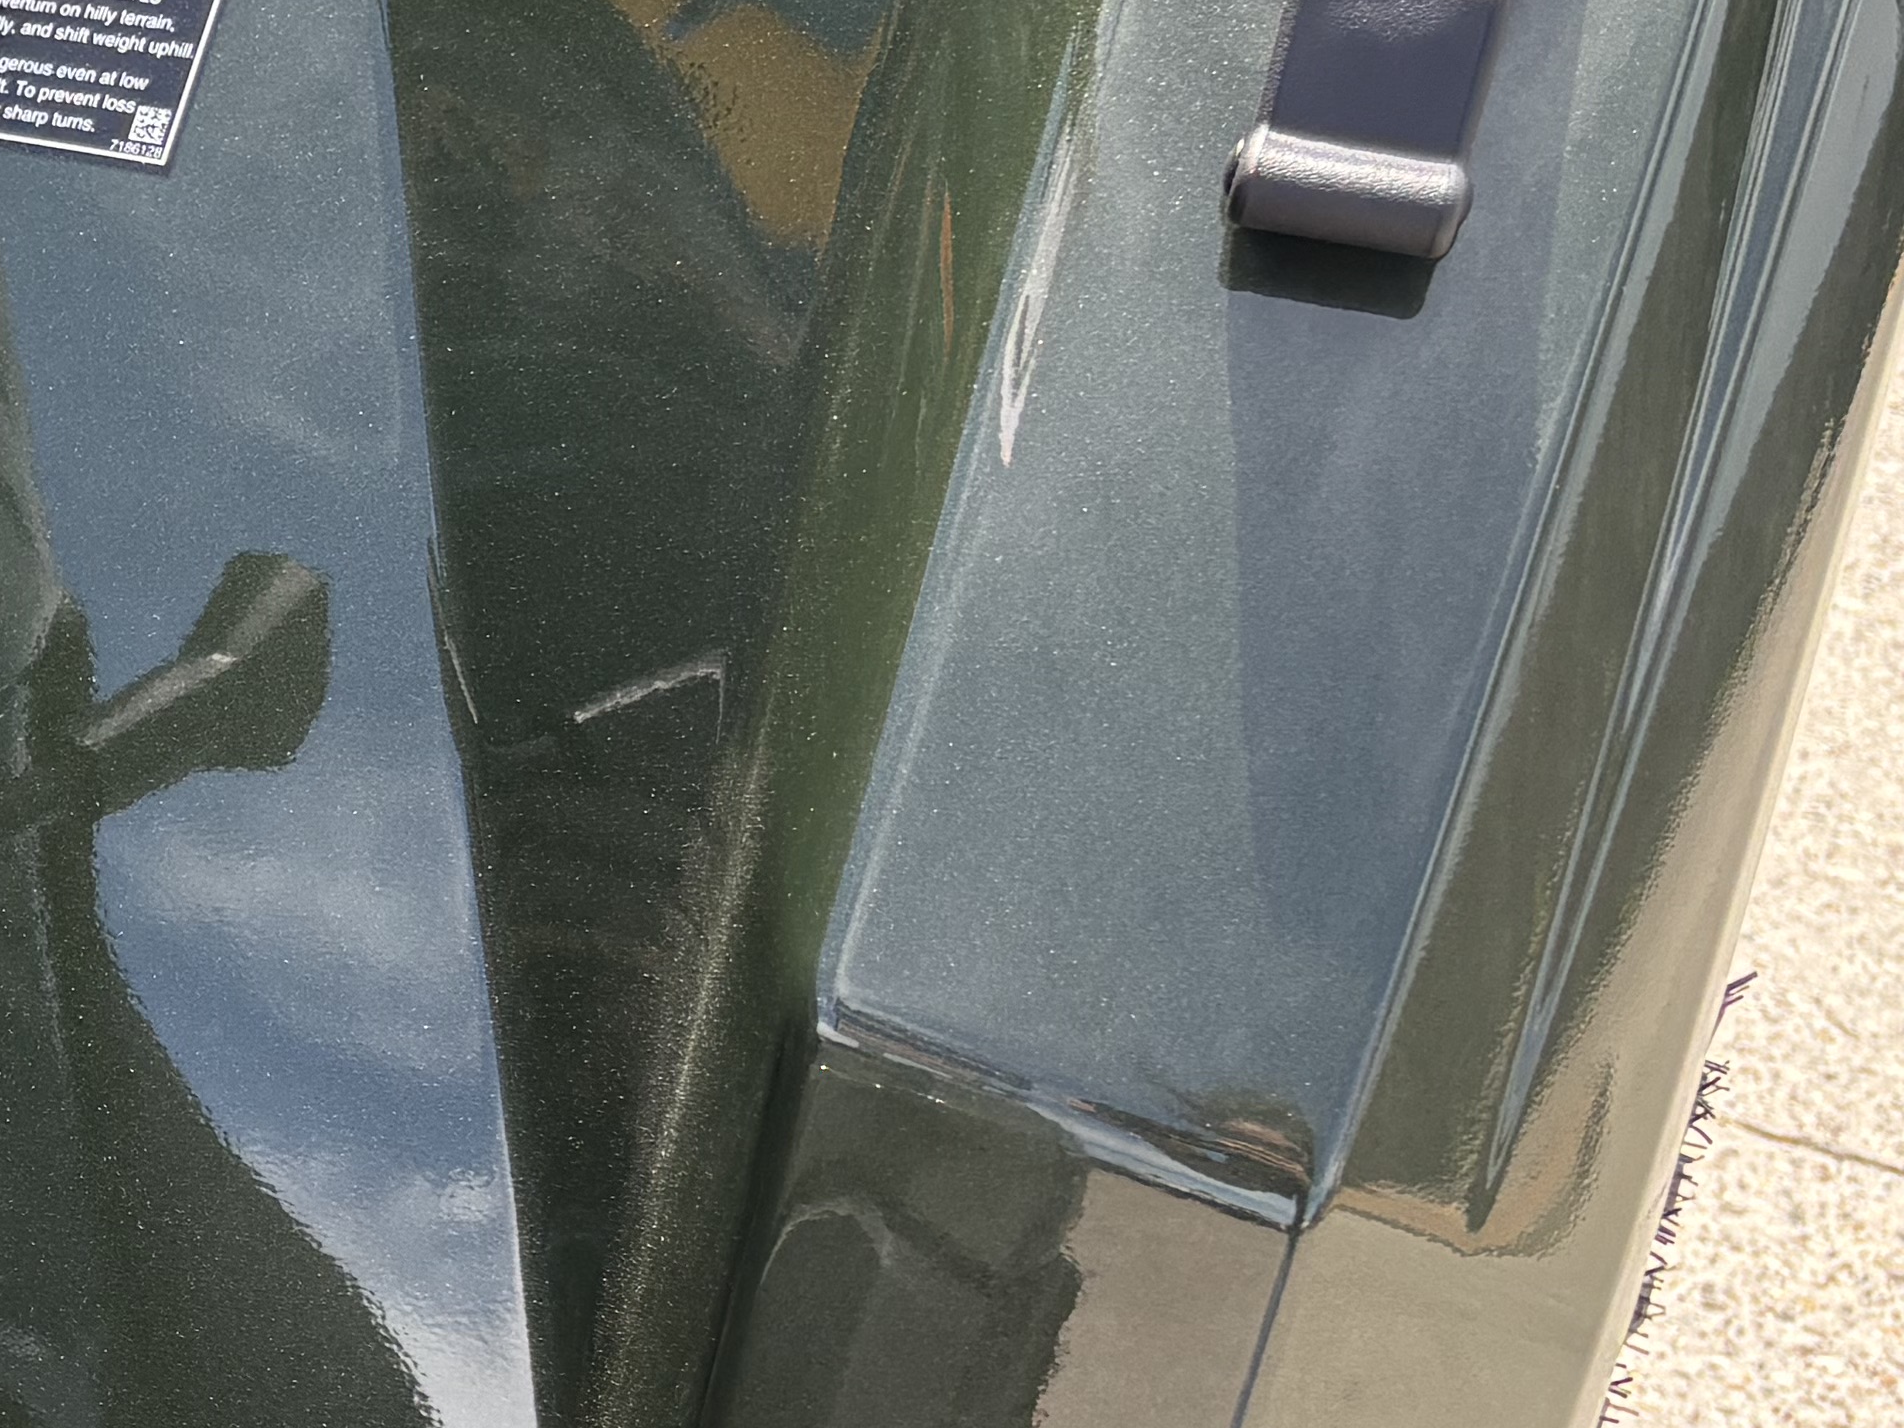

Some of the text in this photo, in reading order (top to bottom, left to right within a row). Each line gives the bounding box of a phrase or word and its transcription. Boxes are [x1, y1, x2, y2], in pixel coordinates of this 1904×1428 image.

[58, 2, 82, 17] on
[83, 2, 118, 26] hilly
[19, 21, 54, 38] and
[53, 24, 90, 43] shift
[92, 32, 147, 53] weight
[147, 39, 194, 59] uphill.
[55, 62, 97, 83] even
[98, 70, 119, 86] at
[118, 70, 149, 90] low
[15, 79, 36, 98] To
[36, 86, 101, 107] prevent
[101, 93, 136, 114] loss
[2, 103, 49, 127] sharp
[51, 111, 95, 132] turns.
[106, 138, 163, 159] 7186128
